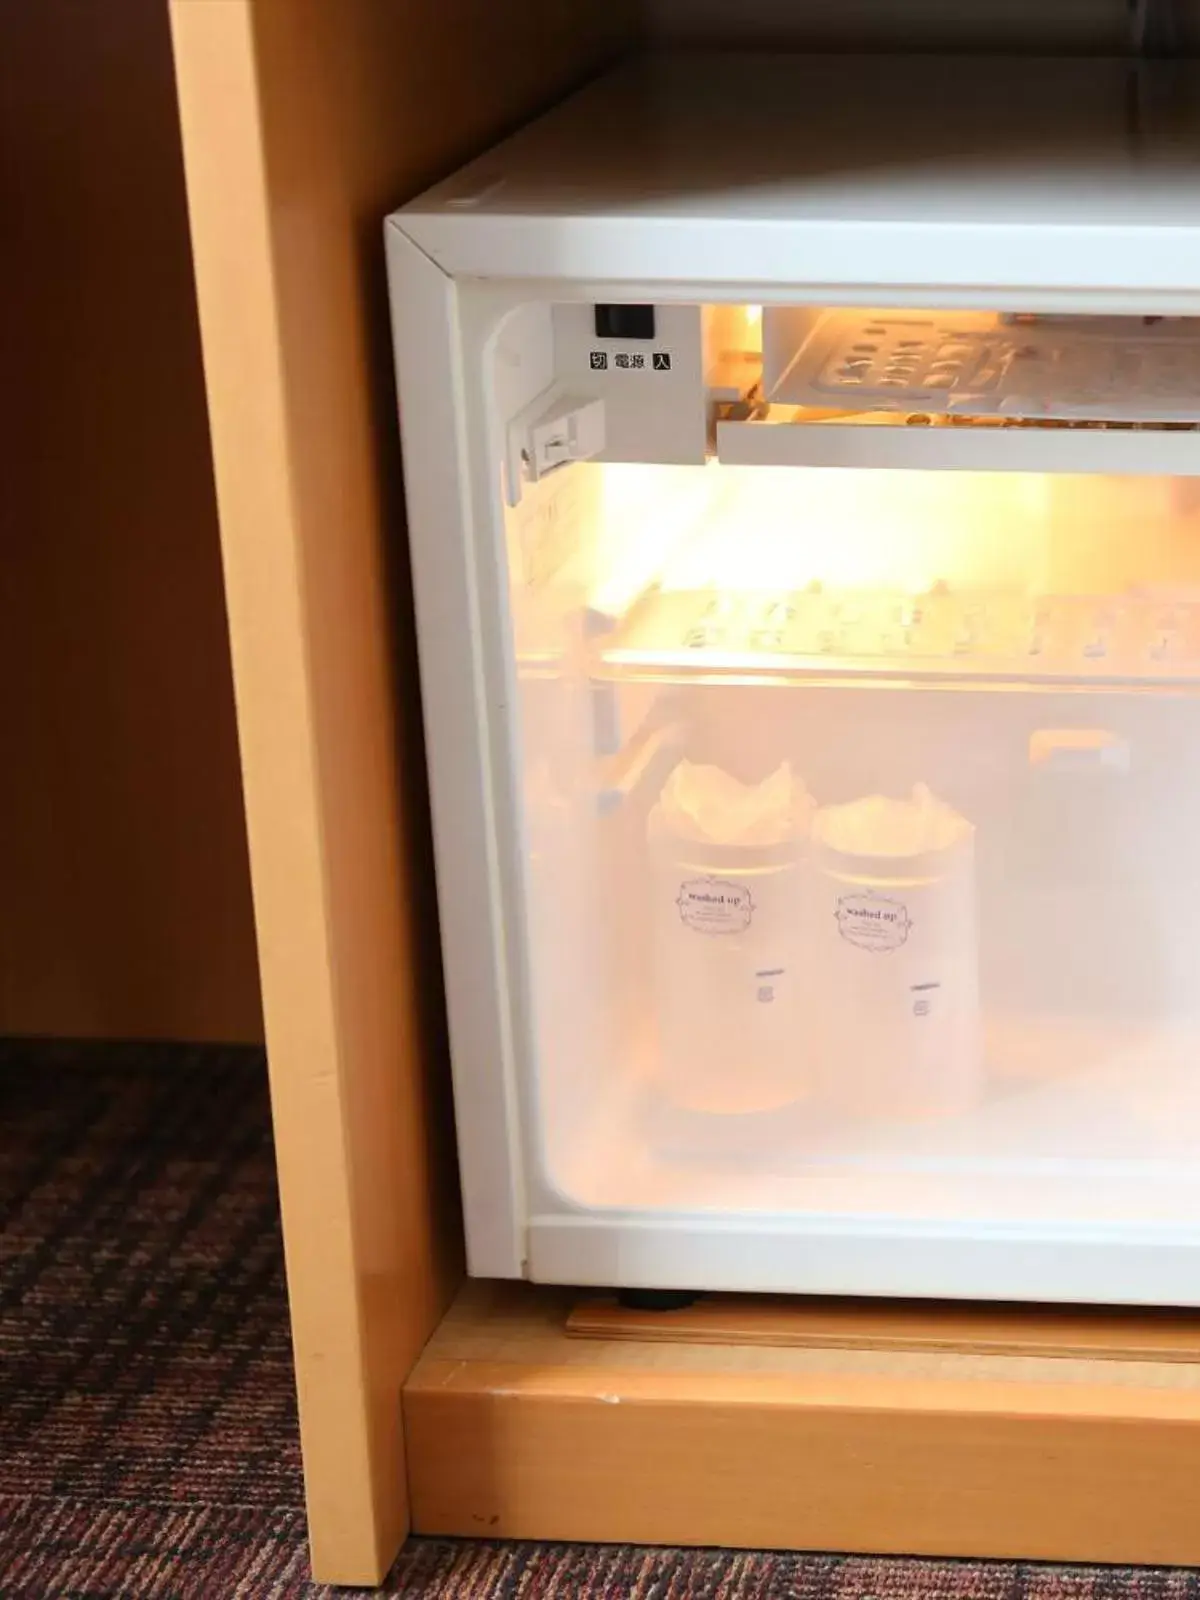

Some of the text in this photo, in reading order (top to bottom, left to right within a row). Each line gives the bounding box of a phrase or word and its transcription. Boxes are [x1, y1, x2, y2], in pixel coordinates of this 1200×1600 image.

[653, 353, 671, 370] 入
[688, 893, 741, 907] washed up
[846, 908, 897, 922] washed up
